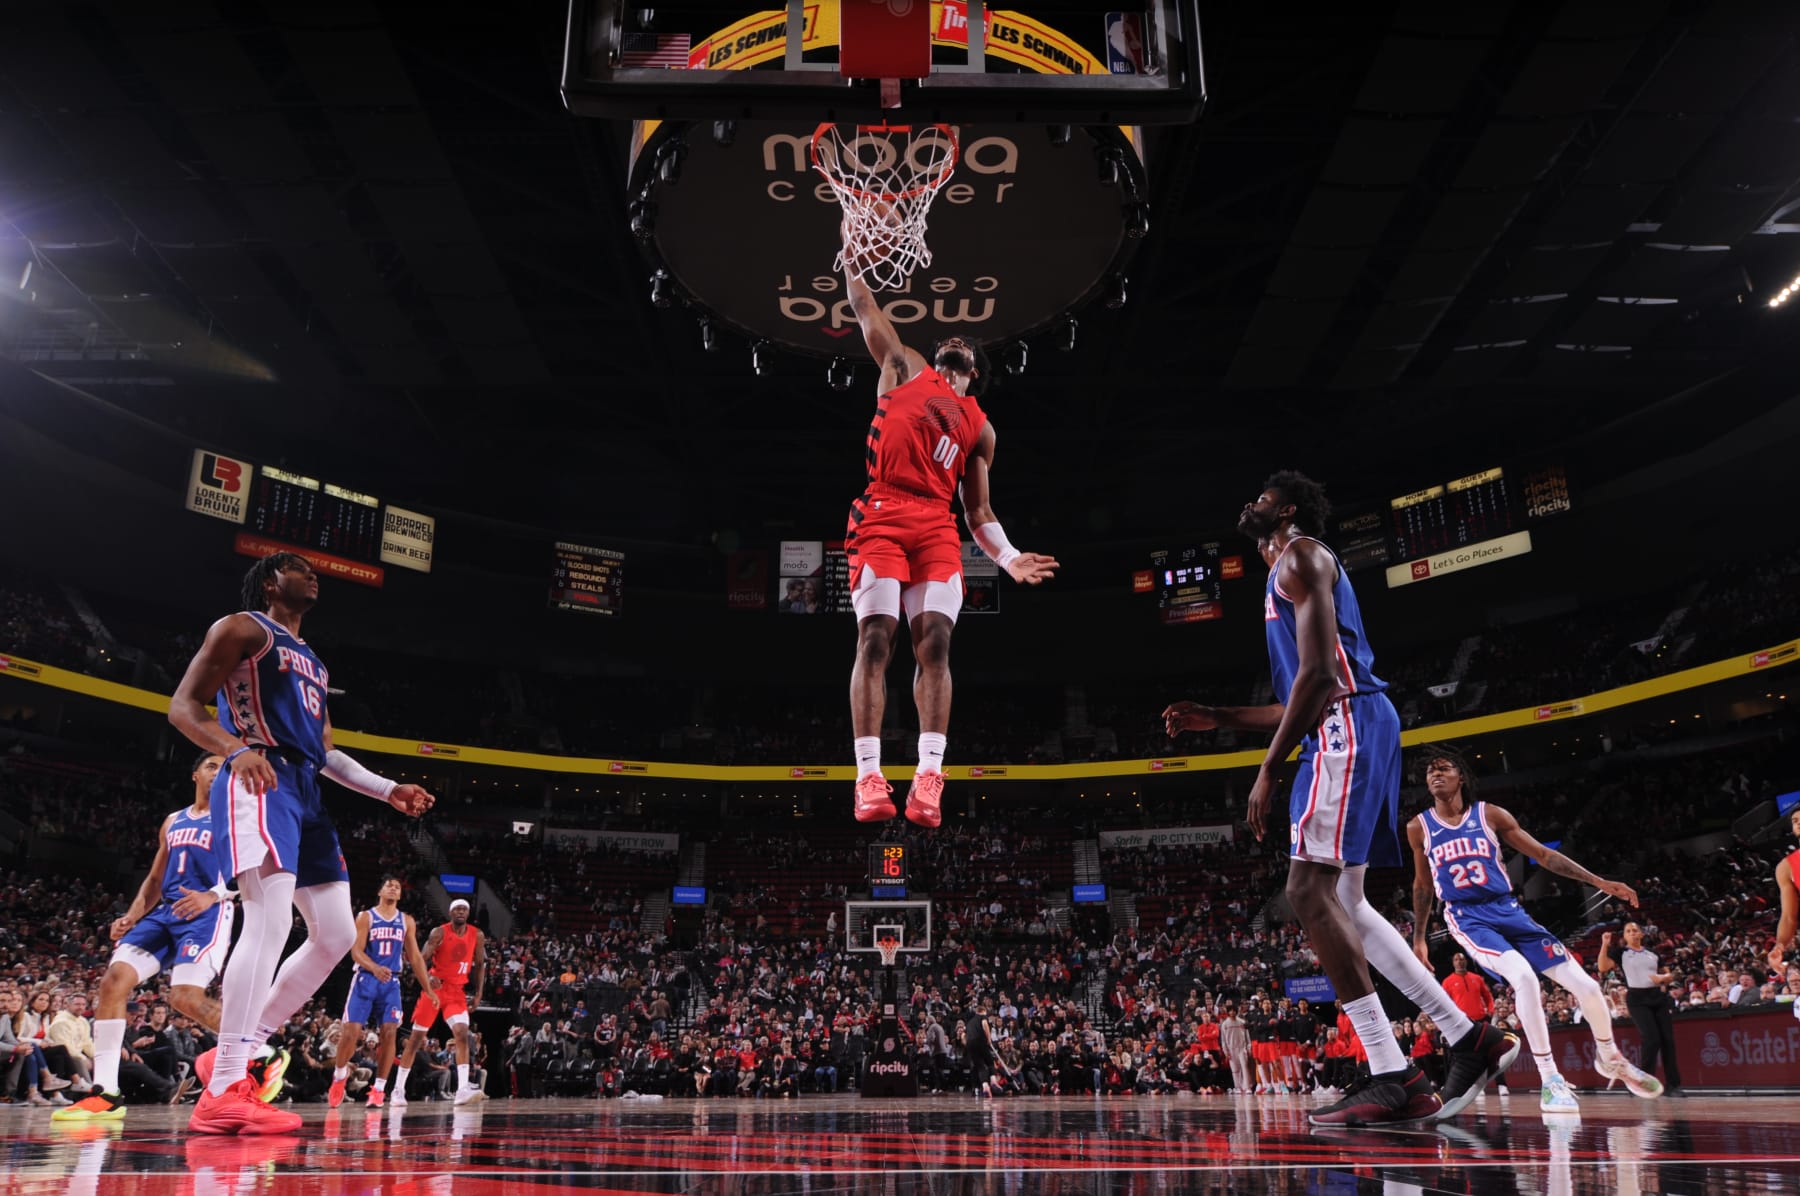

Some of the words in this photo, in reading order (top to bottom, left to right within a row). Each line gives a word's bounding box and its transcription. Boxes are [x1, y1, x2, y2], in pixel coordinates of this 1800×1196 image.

[709, 42, 733, 67] LES
[992, 23, 1020, 44] LES
[1023, 33, 1084, 74] SCHWAB
[762, 125, 1019, 174] moda
[778, 296, 996, 329] moda
[933, 434, 960, 469] 00
[1459, 471, 1489, 484] GUEST
[195, 486, 241, 506] LORENTZ
[1404, 490, 1428, 501] HOME
[194, 496, 240, 517] BRUUN
[1528, 497, 1571, 518] ripcity
[384, 522, 421, 540] BREWING
[395, 514, 431, 532] BARREL
[382, 541, 408, 556] DRINK
[409, 548, 431, 561] BEER
[1433, 557, 1454, 570] Let's
[1455, 553, 1471, 565] Go
[1472, 545, 1504, 560] Places
[351, 567, 378, 580] CITY
[783, 560, 809, 569] moda
[568, 570, 608, 584] REBOUNDS
[570, 581, 604, 593] STEALS
[298, 680, 322, 719] 16
[167, 827, 213, 852] PHILA
[640, 838, 665, 849] ROW
[1114, 835, 1143, 846] Sprite
[1151, 833, 1168, 844] RIP
[1169, 832, 1193, 843] CITY
[1195, 831, 1220, 842] ROW
[177, 850, 188, 874] 1
[883, 847, 904, 858] 1:23
[1431, 837, 1492, 867] PHILA
[883, 857, 901, 877] 16
[1449, 860, 1489, 889] 23
[369, 926, 404, 942] PHILA
[378, 941, 392, 957] 11
[870, 1060, 909, 1077] ripcity
